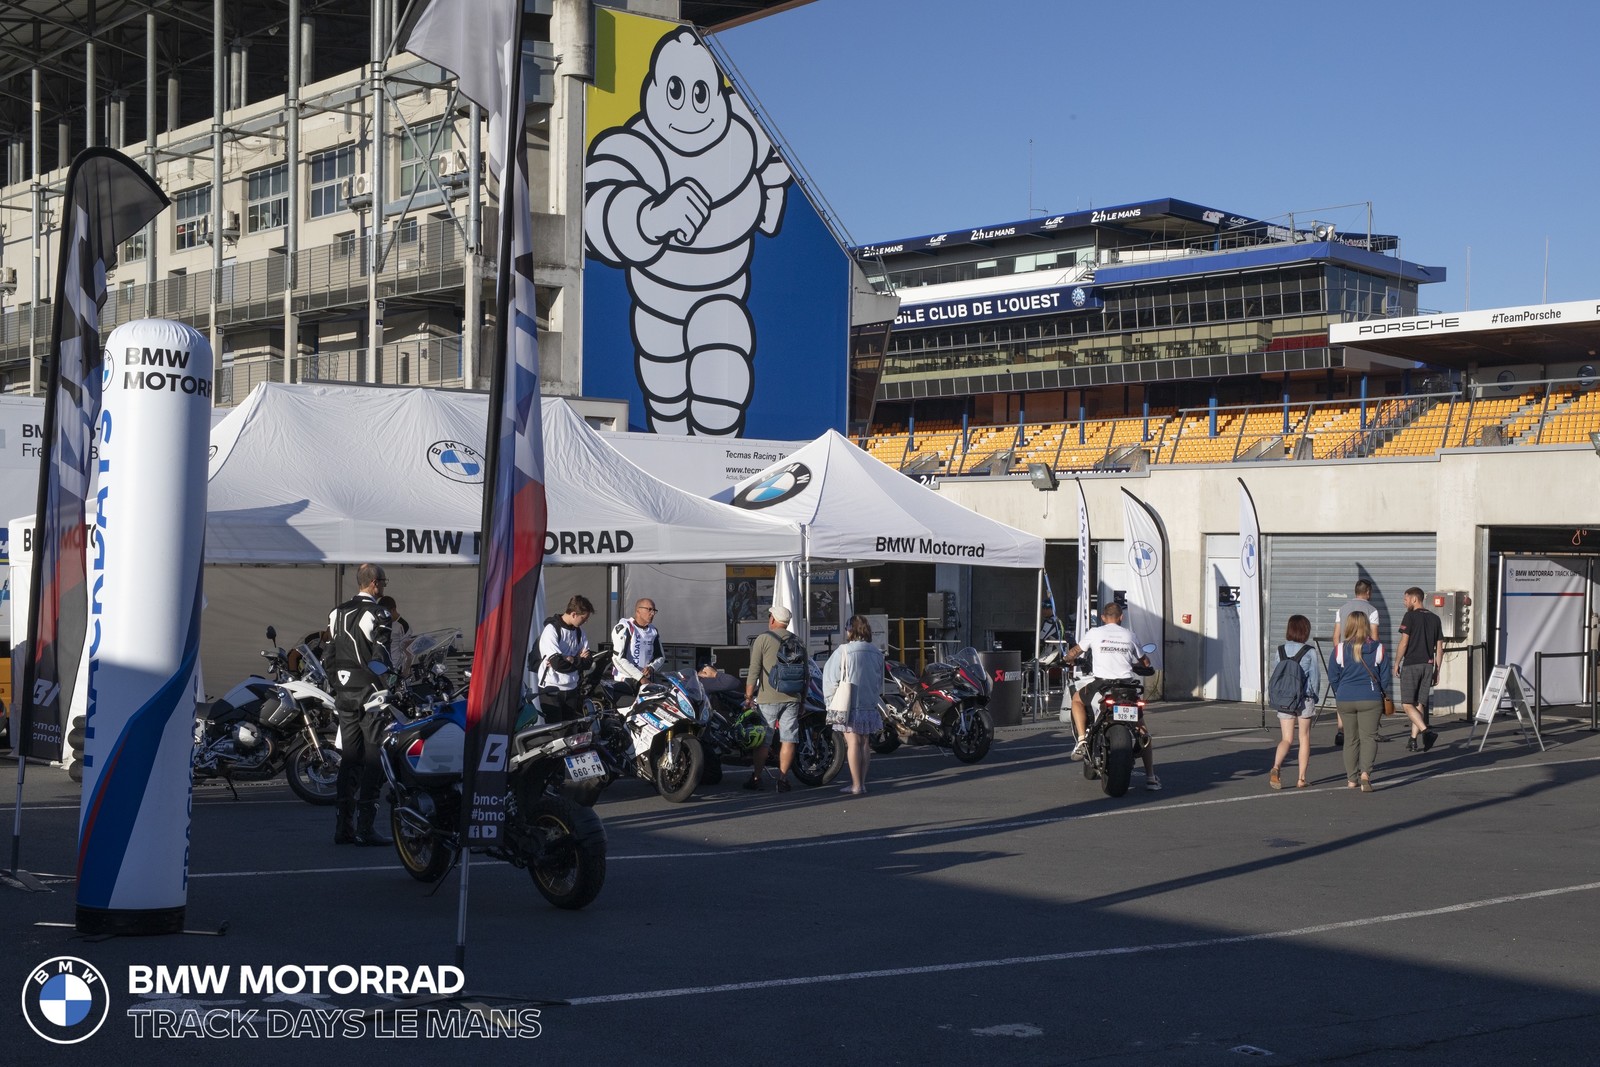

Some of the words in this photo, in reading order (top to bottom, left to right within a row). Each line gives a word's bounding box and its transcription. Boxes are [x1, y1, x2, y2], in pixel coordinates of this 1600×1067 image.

[1107, 212, 1118, 221] LE
[1118, 208, 1141, 219] MANS
[985, 231, 993, 239] LE
[994, 227, 1016, 238] MANS
[884, 244, 904, 254] MANS
[929, 306, 968, 321] CLUB
[973, 302, 993, 316] DE
[997, 293, 1061, 313] L'OUEST
[1491, 308, 1562, 324] #TeamPorsche
[1358, 317, 1460, 336] PORSCHE
[125, 347, 191, 369] BMW
[725, 450, 752, 460] Tecmas
[753, 451, 777, 462] Racing
[385, 527, 463, 554] BMW
[875, 536, 916, 554] BMW
[919, 538, 985, 558] Motorrad
[1527, 569, 1554, 577] MOTORRAD
